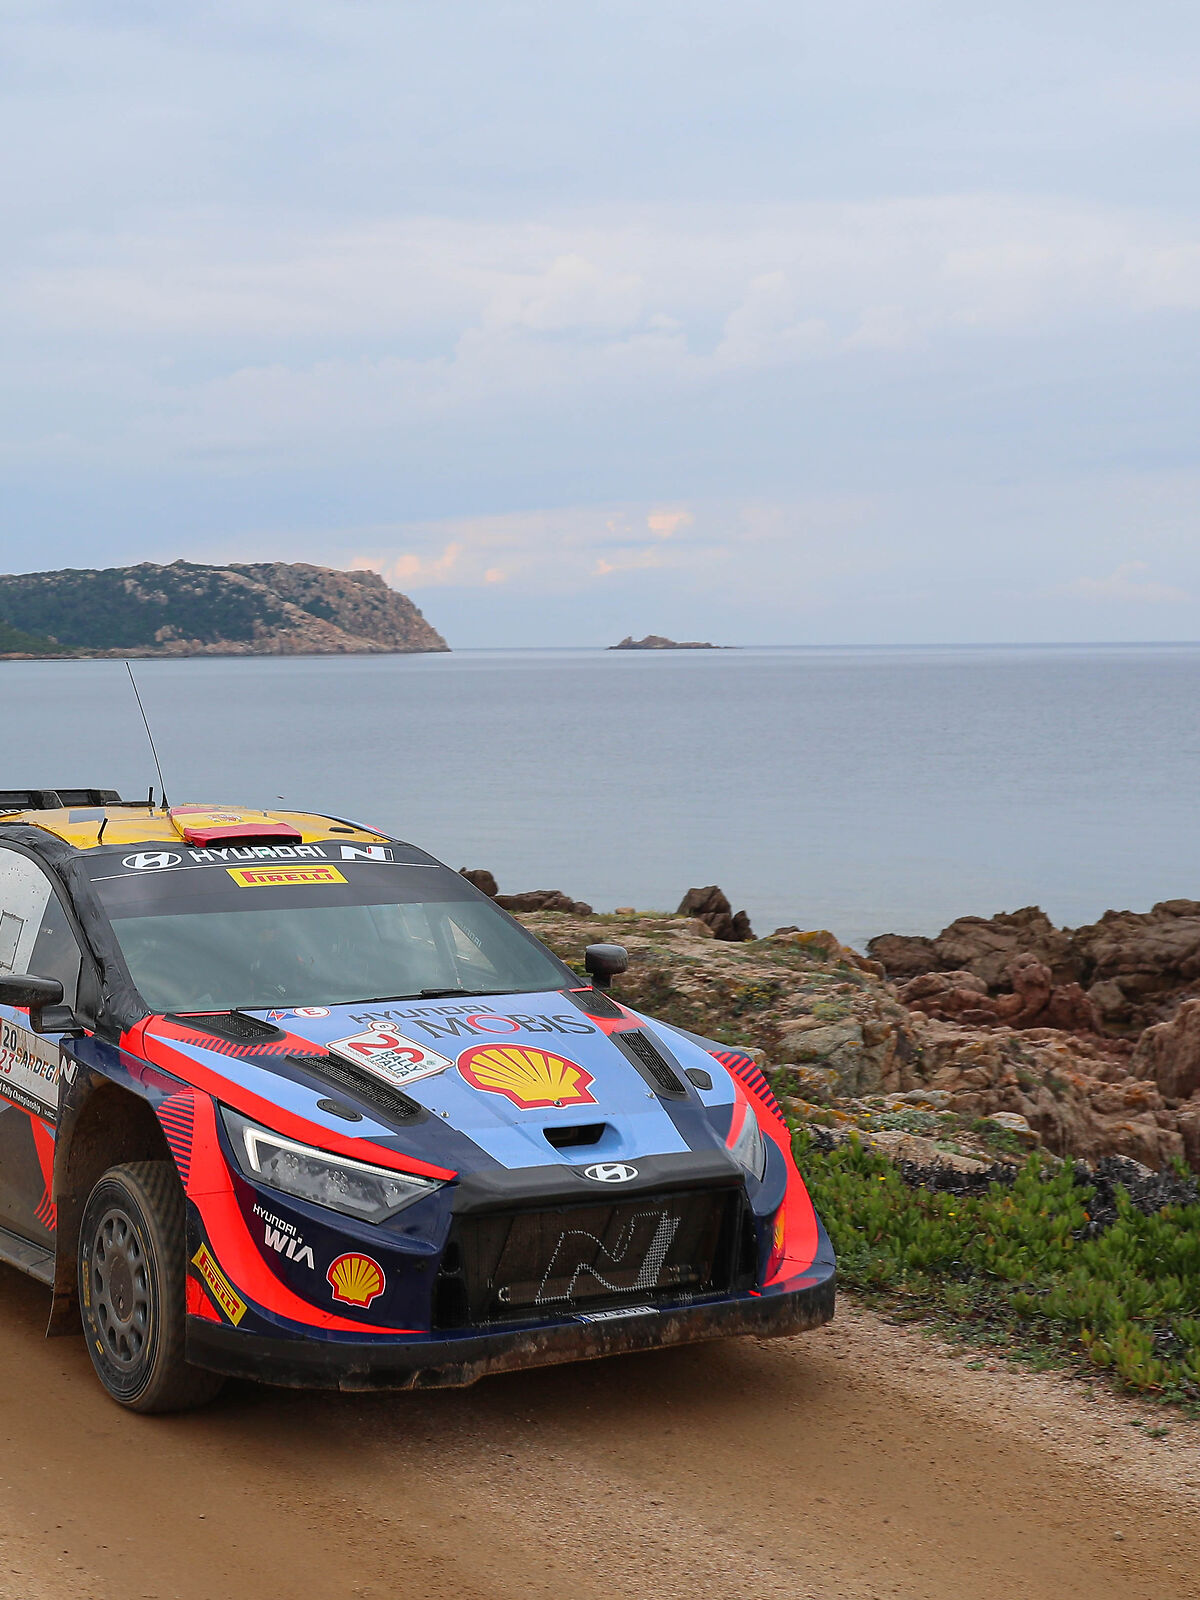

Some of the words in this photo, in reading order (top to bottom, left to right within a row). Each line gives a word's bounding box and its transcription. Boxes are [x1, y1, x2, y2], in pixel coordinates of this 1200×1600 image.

[191, 845, 328, 863] HYUNDAI
[240, 867, 335, 883] PIRELLI
[348, 1004, 497, 1024] HYUNDAI
[412, 1013, 597, 1039] MOBIS
[2, 1025, 17, 1051] 20
[15, 1047, 59, 1086] SARDEGN
[370, 1054, 413, 1077] ITALIA
[380, 1050, 424, 1073] RALLY
[2, 1083, 13, 1098] Rally
[12, 1089, 41, 1114] Championship
[252, 1203, 297, 1237] HYUNDAI
[264, 1224, 315, 1270] WIA
[199, 1251, 241, 1317] PIRELLI
